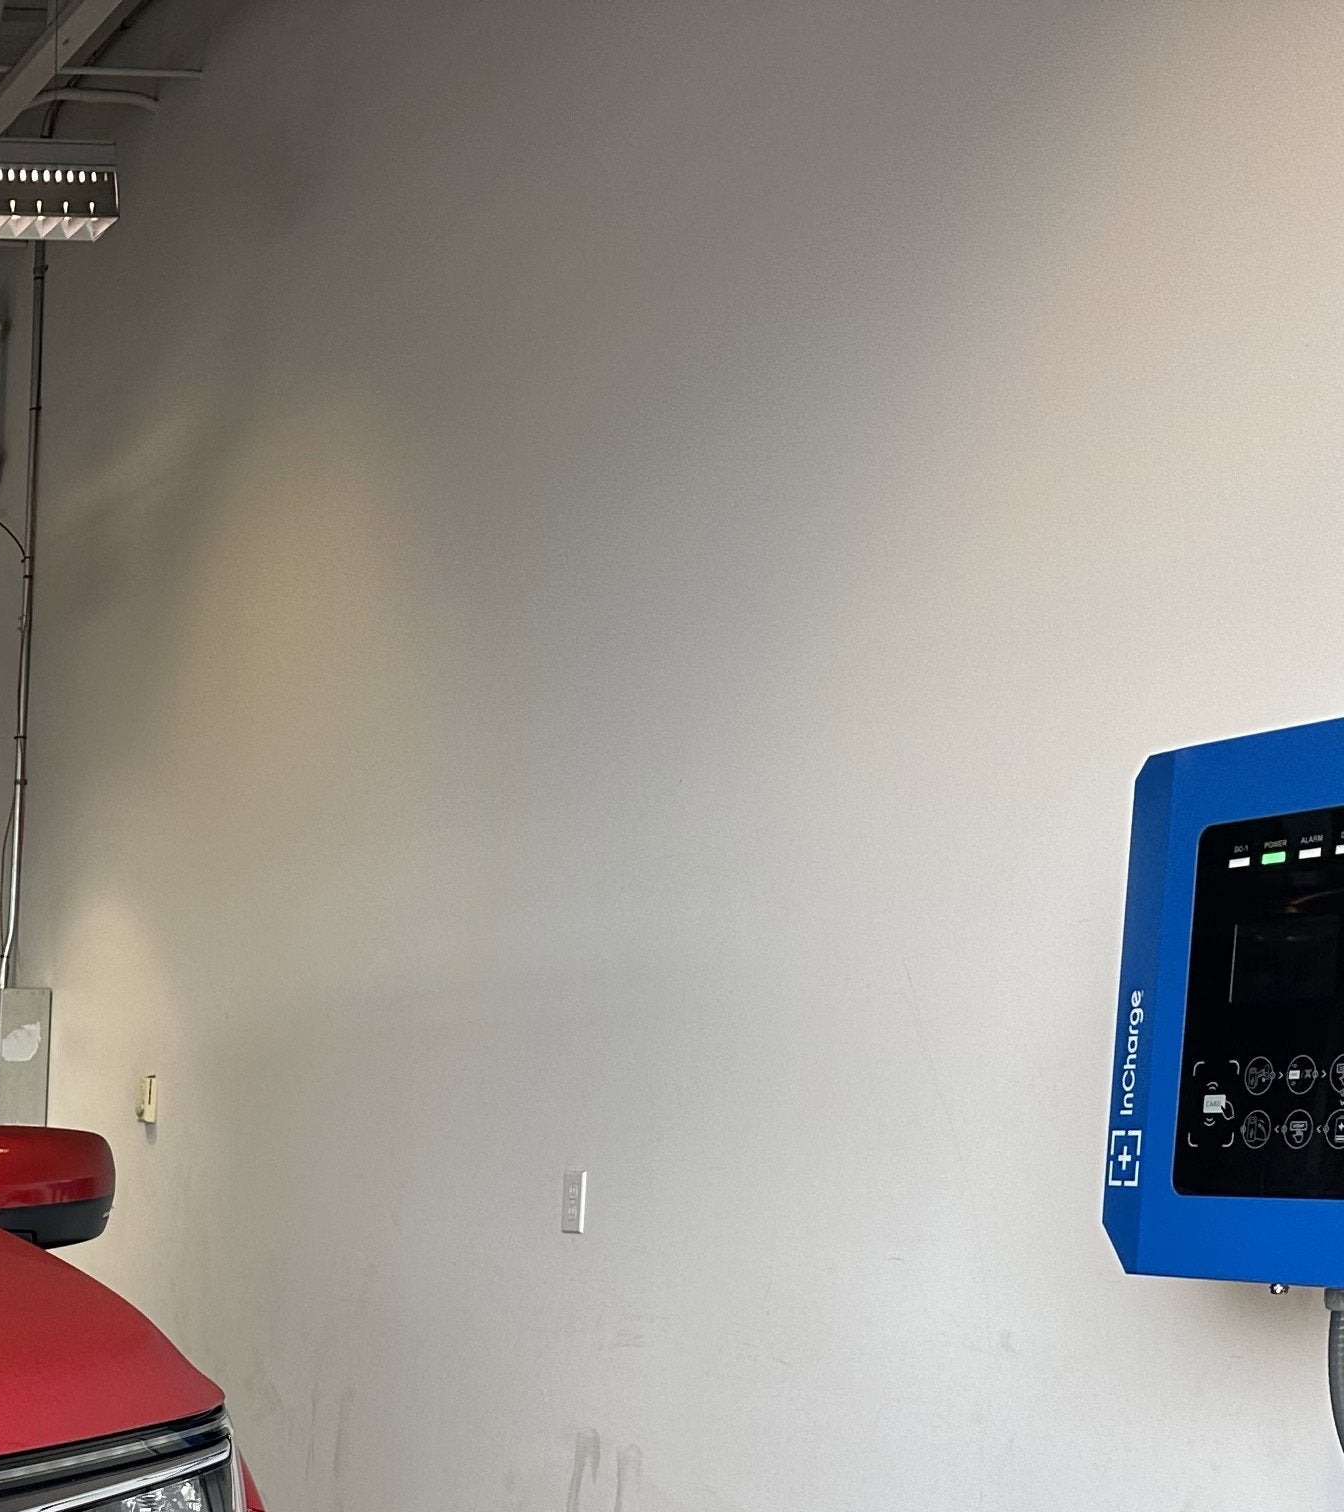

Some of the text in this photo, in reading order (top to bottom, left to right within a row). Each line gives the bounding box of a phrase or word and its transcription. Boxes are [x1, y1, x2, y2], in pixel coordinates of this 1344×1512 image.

[1263, 839, 1288, 849] POWER
[1300, 834, 1324, 844] ALARM
[1120, 990, 1144, 1115] InCharge
